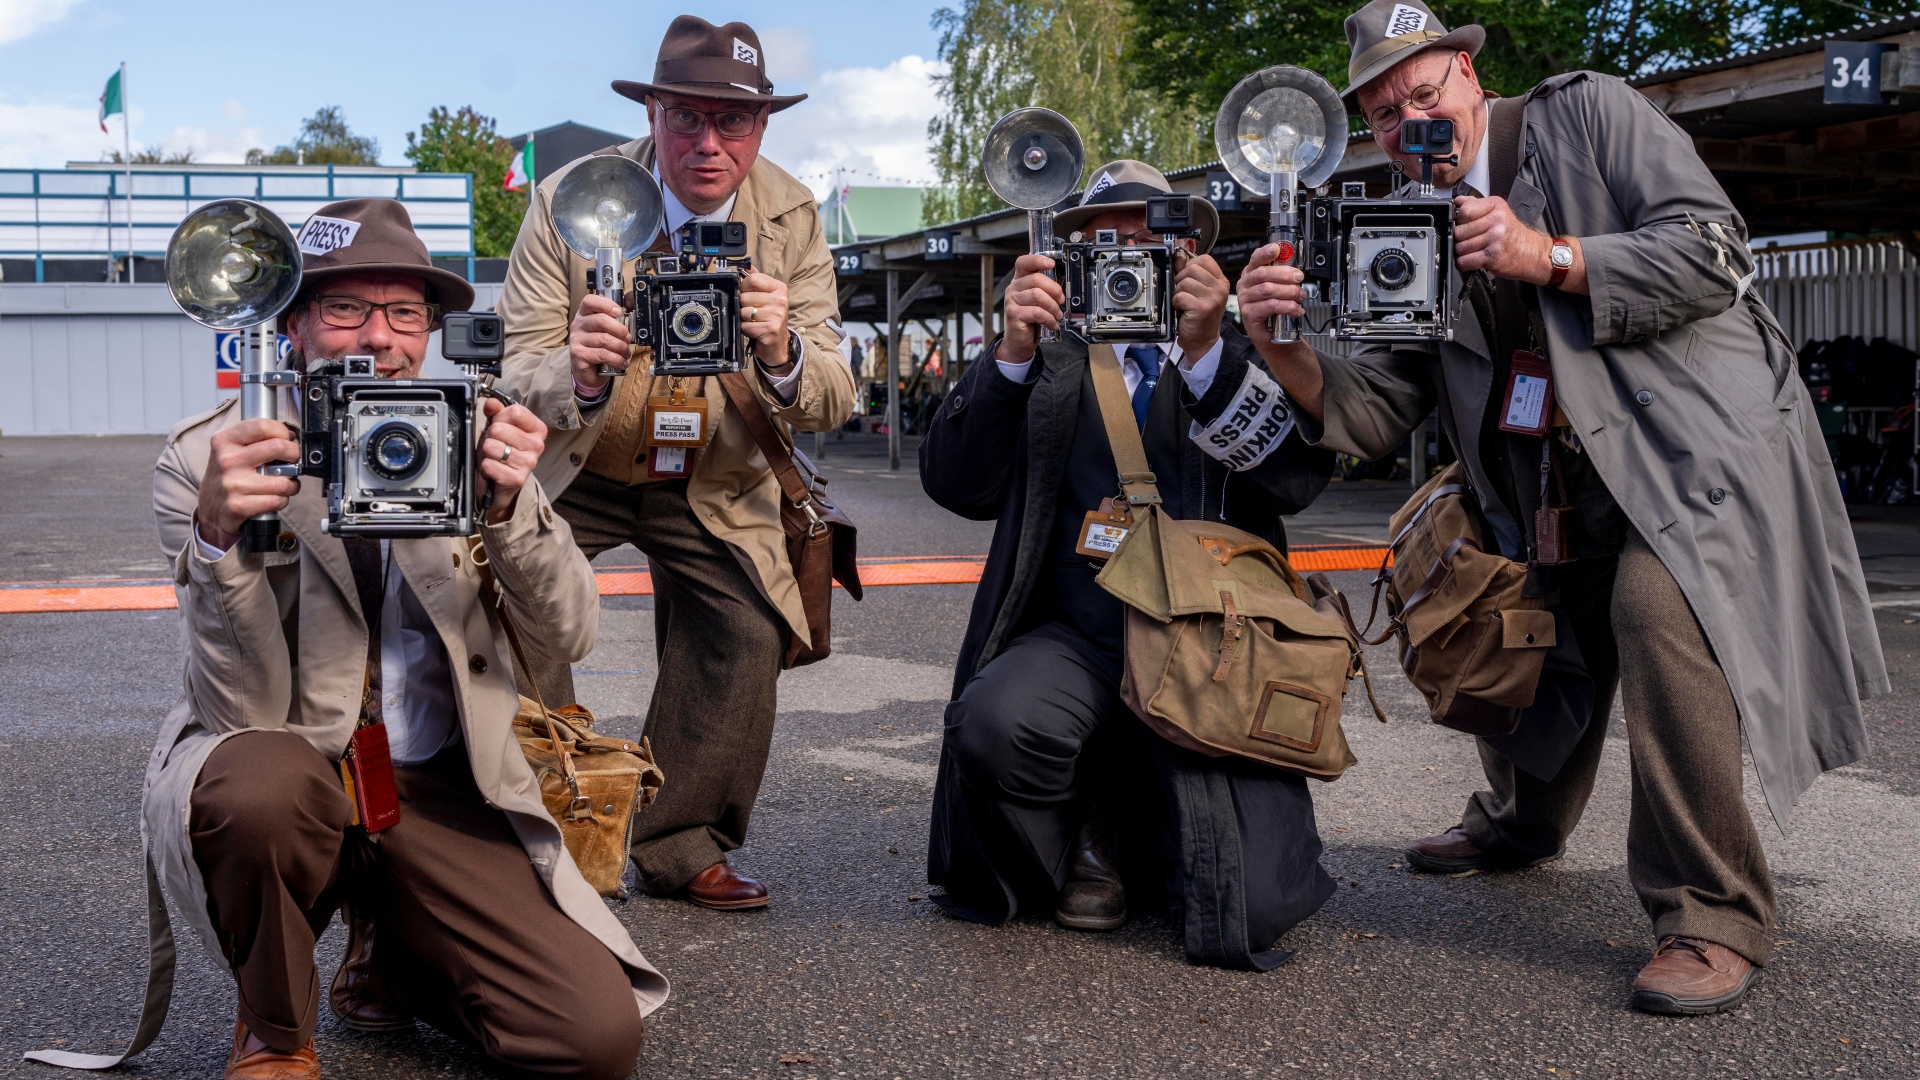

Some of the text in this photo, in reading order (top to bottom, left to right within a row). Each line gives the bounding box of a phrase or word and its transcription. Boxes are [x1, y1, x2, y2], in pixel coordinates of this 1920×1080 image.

[1831, 56, 1871, 88] 34
[1210, 180, 1236, 201] 32
[301, 219, 350, 251] PRESS
[927, 237, 949, 253] 30
[839, 255, 859, 270] 29
[1209, 384, 1269, 448] PRESS
[1088, 539, 1111, 548] PRESS
